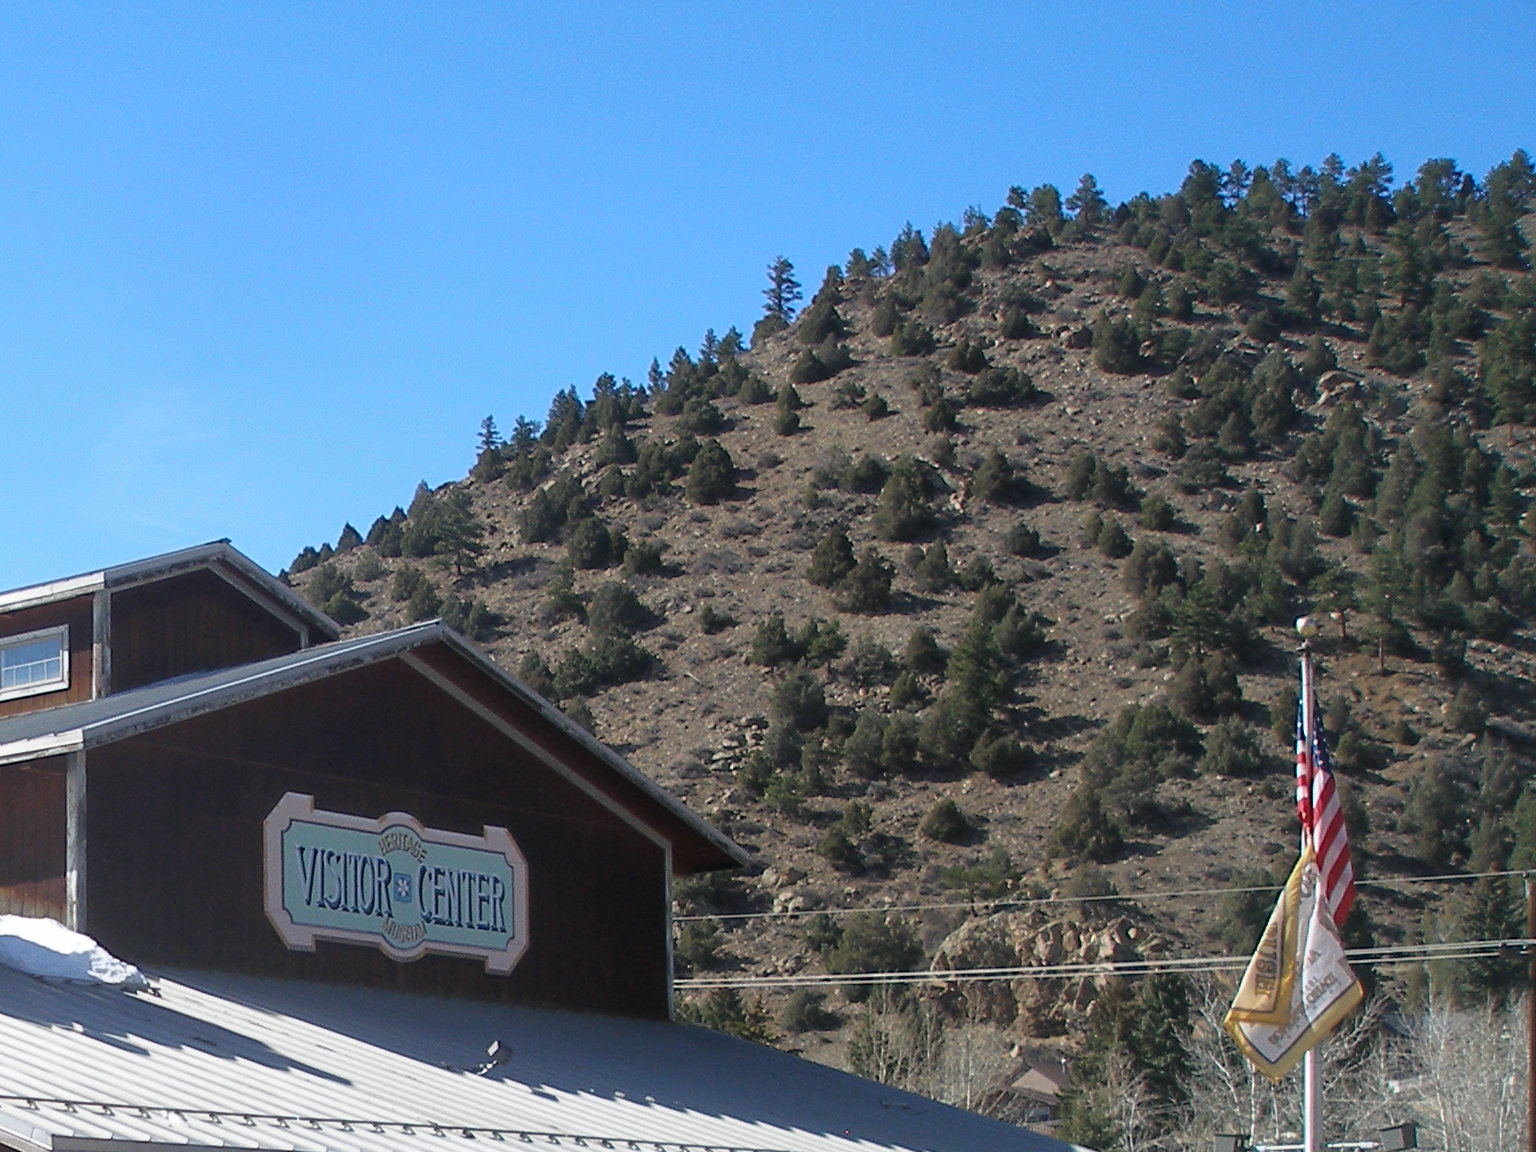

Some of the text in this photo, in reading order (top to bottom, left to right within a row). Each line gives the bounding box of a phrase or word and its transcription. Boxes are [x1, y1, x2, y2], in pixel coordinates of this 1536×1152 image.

[378, 832, 428, 863] HERITAGE
[295, 844, 507, 933] VISITOR CENTER
[382, 917, 428, 943] MUSEUM
